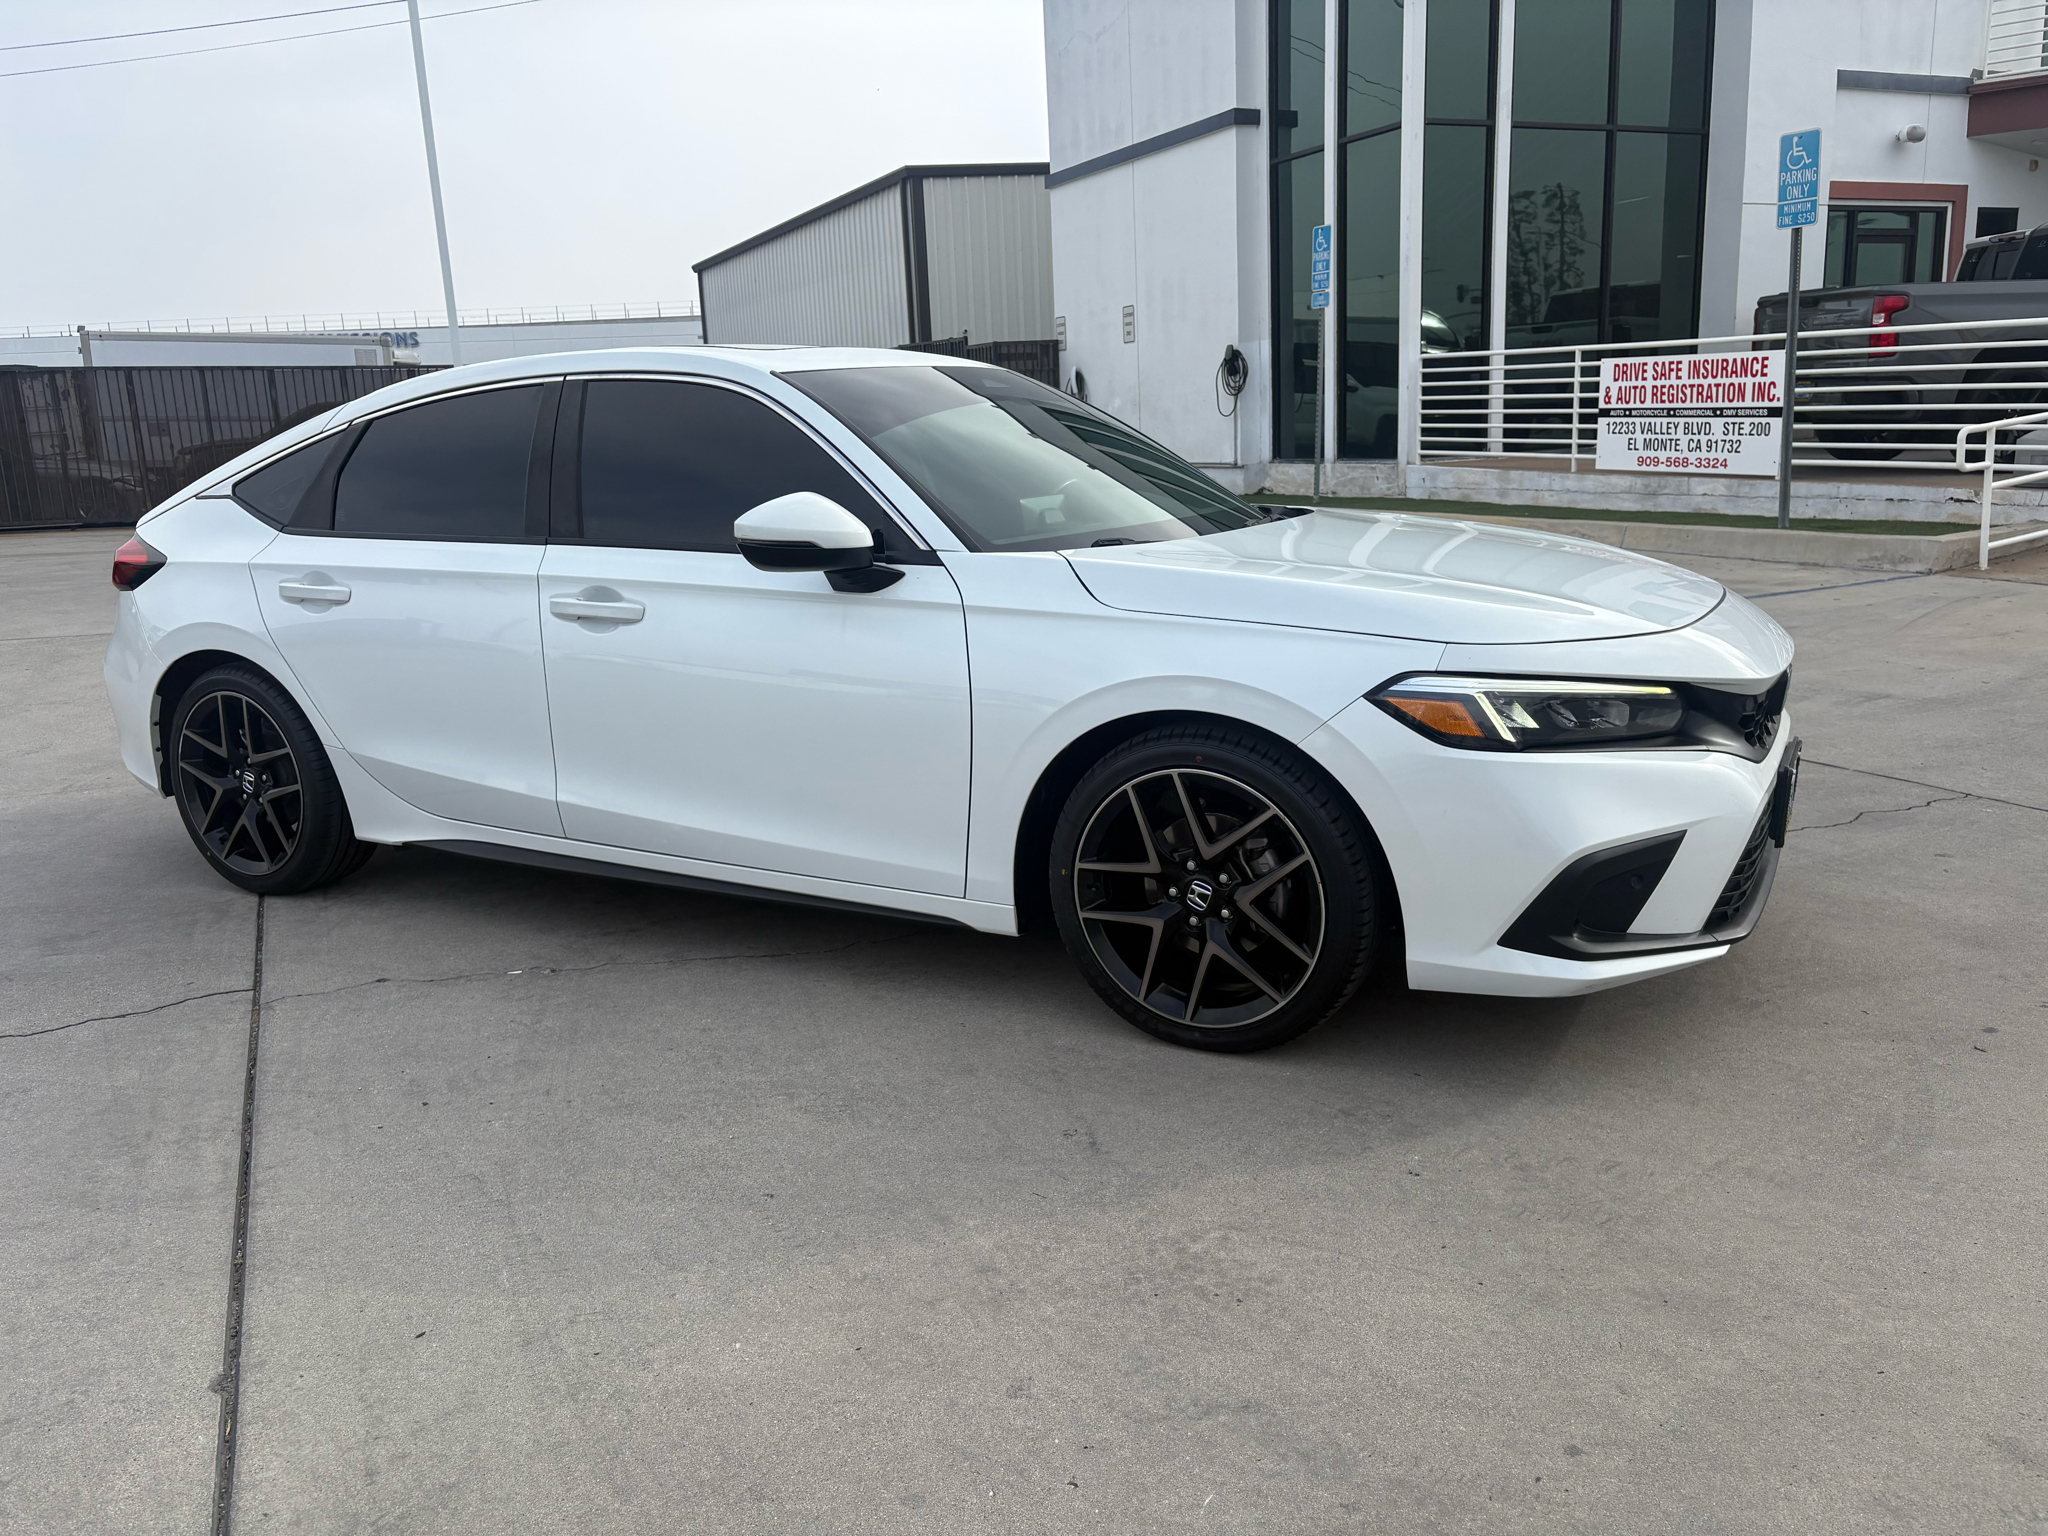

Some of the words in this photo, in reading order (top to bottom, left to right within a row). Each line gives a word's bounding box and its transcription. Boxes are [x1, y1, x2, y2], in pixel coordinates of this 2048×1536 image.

[1780, 167, 1817, 186] PARKING
[1786, 184, 1810, 200] ONLY
[1783, 201, 1811, 214] MINIMUM
[1778, 216, 1793, 226] FINE
[1613, 362, 1648, 382] DRIVE
[1652, 360, 1683, 381] SAFE
[1687, 356, 1769, 380] INSURANCE
[1603, 386, 1612, 405] &
[1616, 385, 1647, 405] AUTO
[1651, 382, 1746, 405] REGISTRATION
[1751, 381, 1781, 403] INC.
[1609, 409, 1625, 417] AUTO
[1631, 409, 1668, 417] MOTORCYCLE
[1722, 408, 1737, 416] DMV
[1737, 408, 1768, 416] SERVICES
[1605, 421, 1636, 435] 12233
[1639, 421, 1680, 435] VALLEY
[1683, 421, 1715, 436] BLVD.
[1722, 421, 1771, 437] STE.200
[1627, 437, 1639, 451] EL
[1643, 438, 1683, 454] MONTE,
[1687, 438, 1702, 453] CA
[1706, 439, 1742, 454] 91732
[1636, 455, 1728, 469] 909-568-3324
